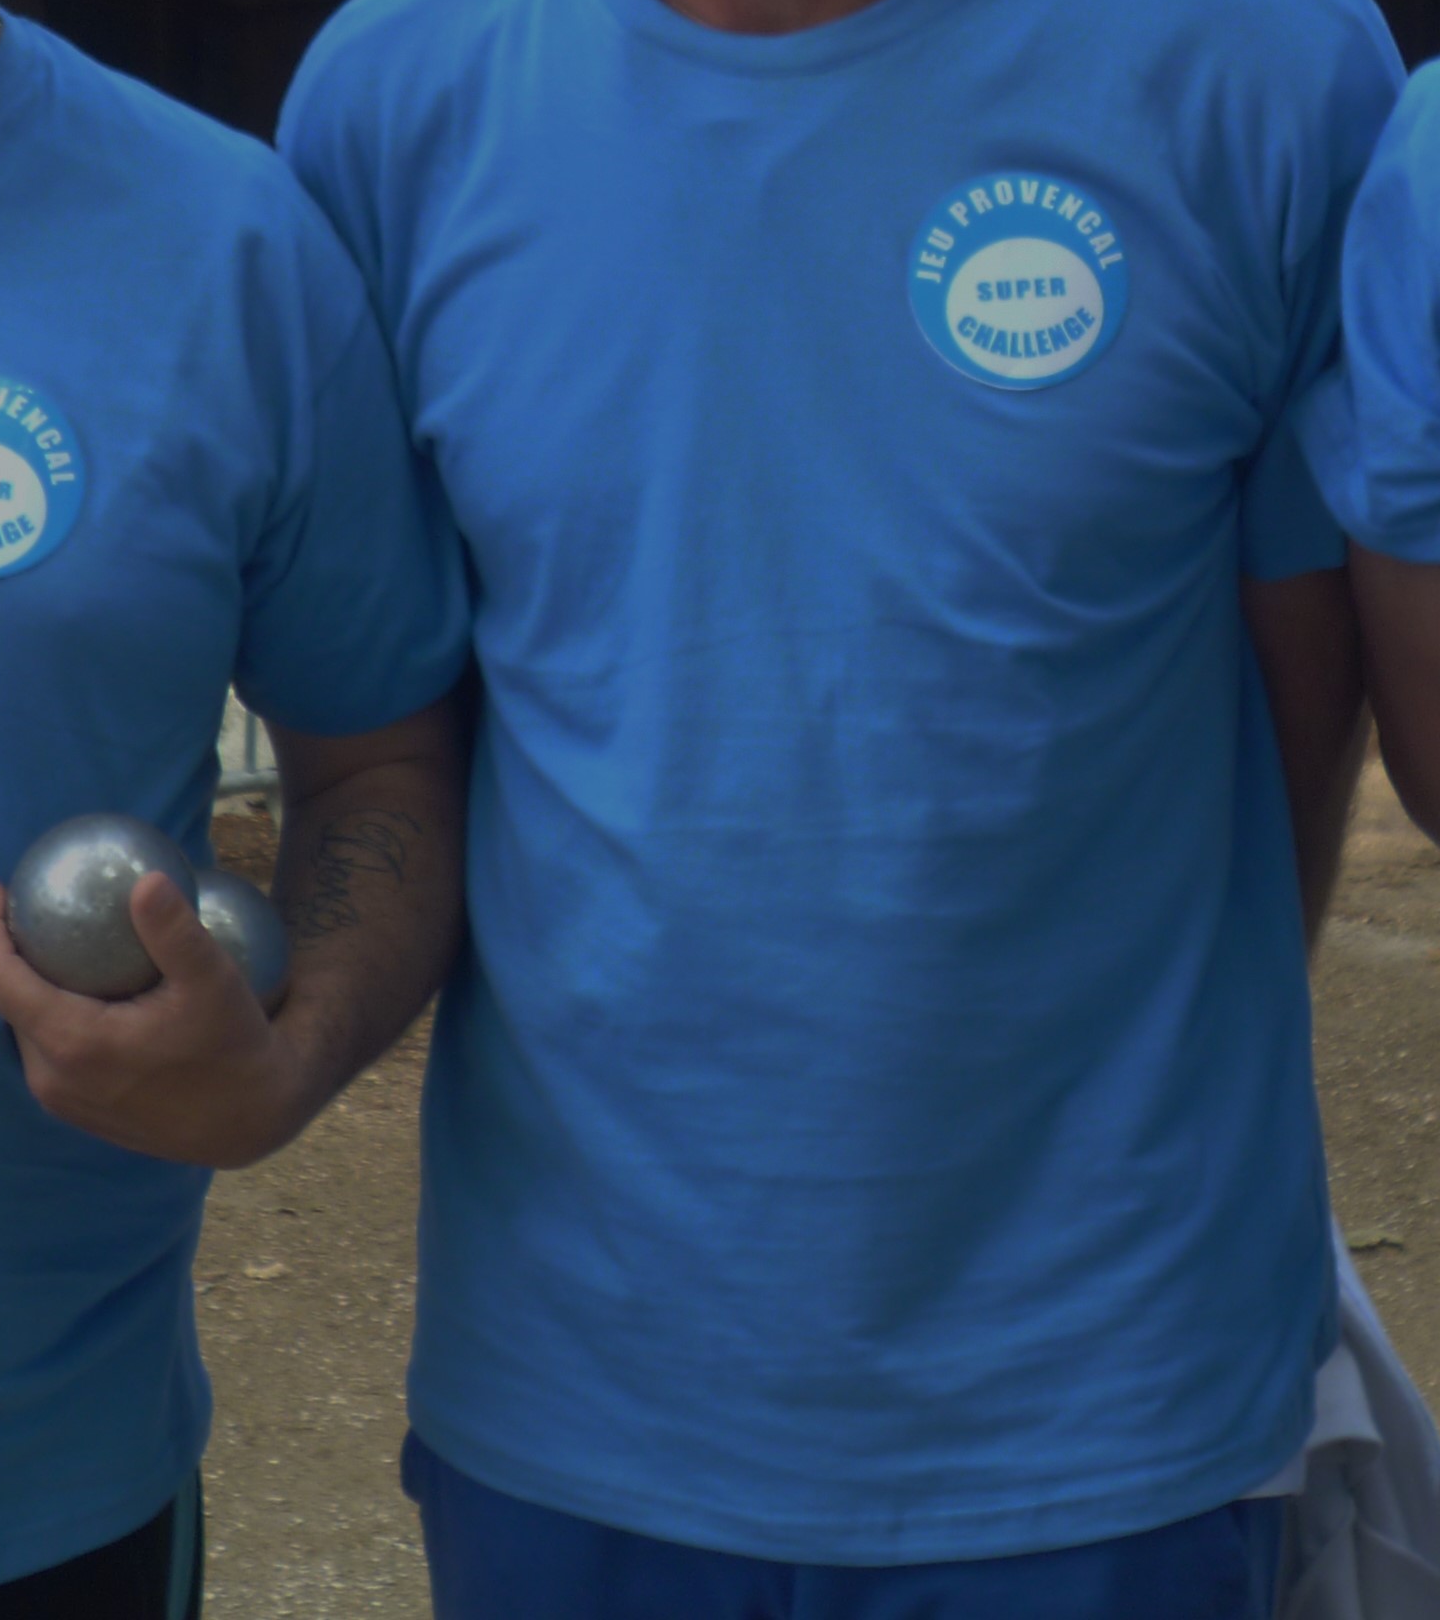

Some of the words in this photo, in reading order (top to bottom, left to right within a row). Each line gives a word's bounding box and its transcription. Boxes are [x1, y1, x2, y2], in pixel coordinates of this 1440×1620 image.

[915, 227, 955, 284] JEU
[947, 179, 1124, 270] PROVENCAL
[976, 277, 1067, 302] SUPER
[957, 306, 1096, 359] CHALLENGE
